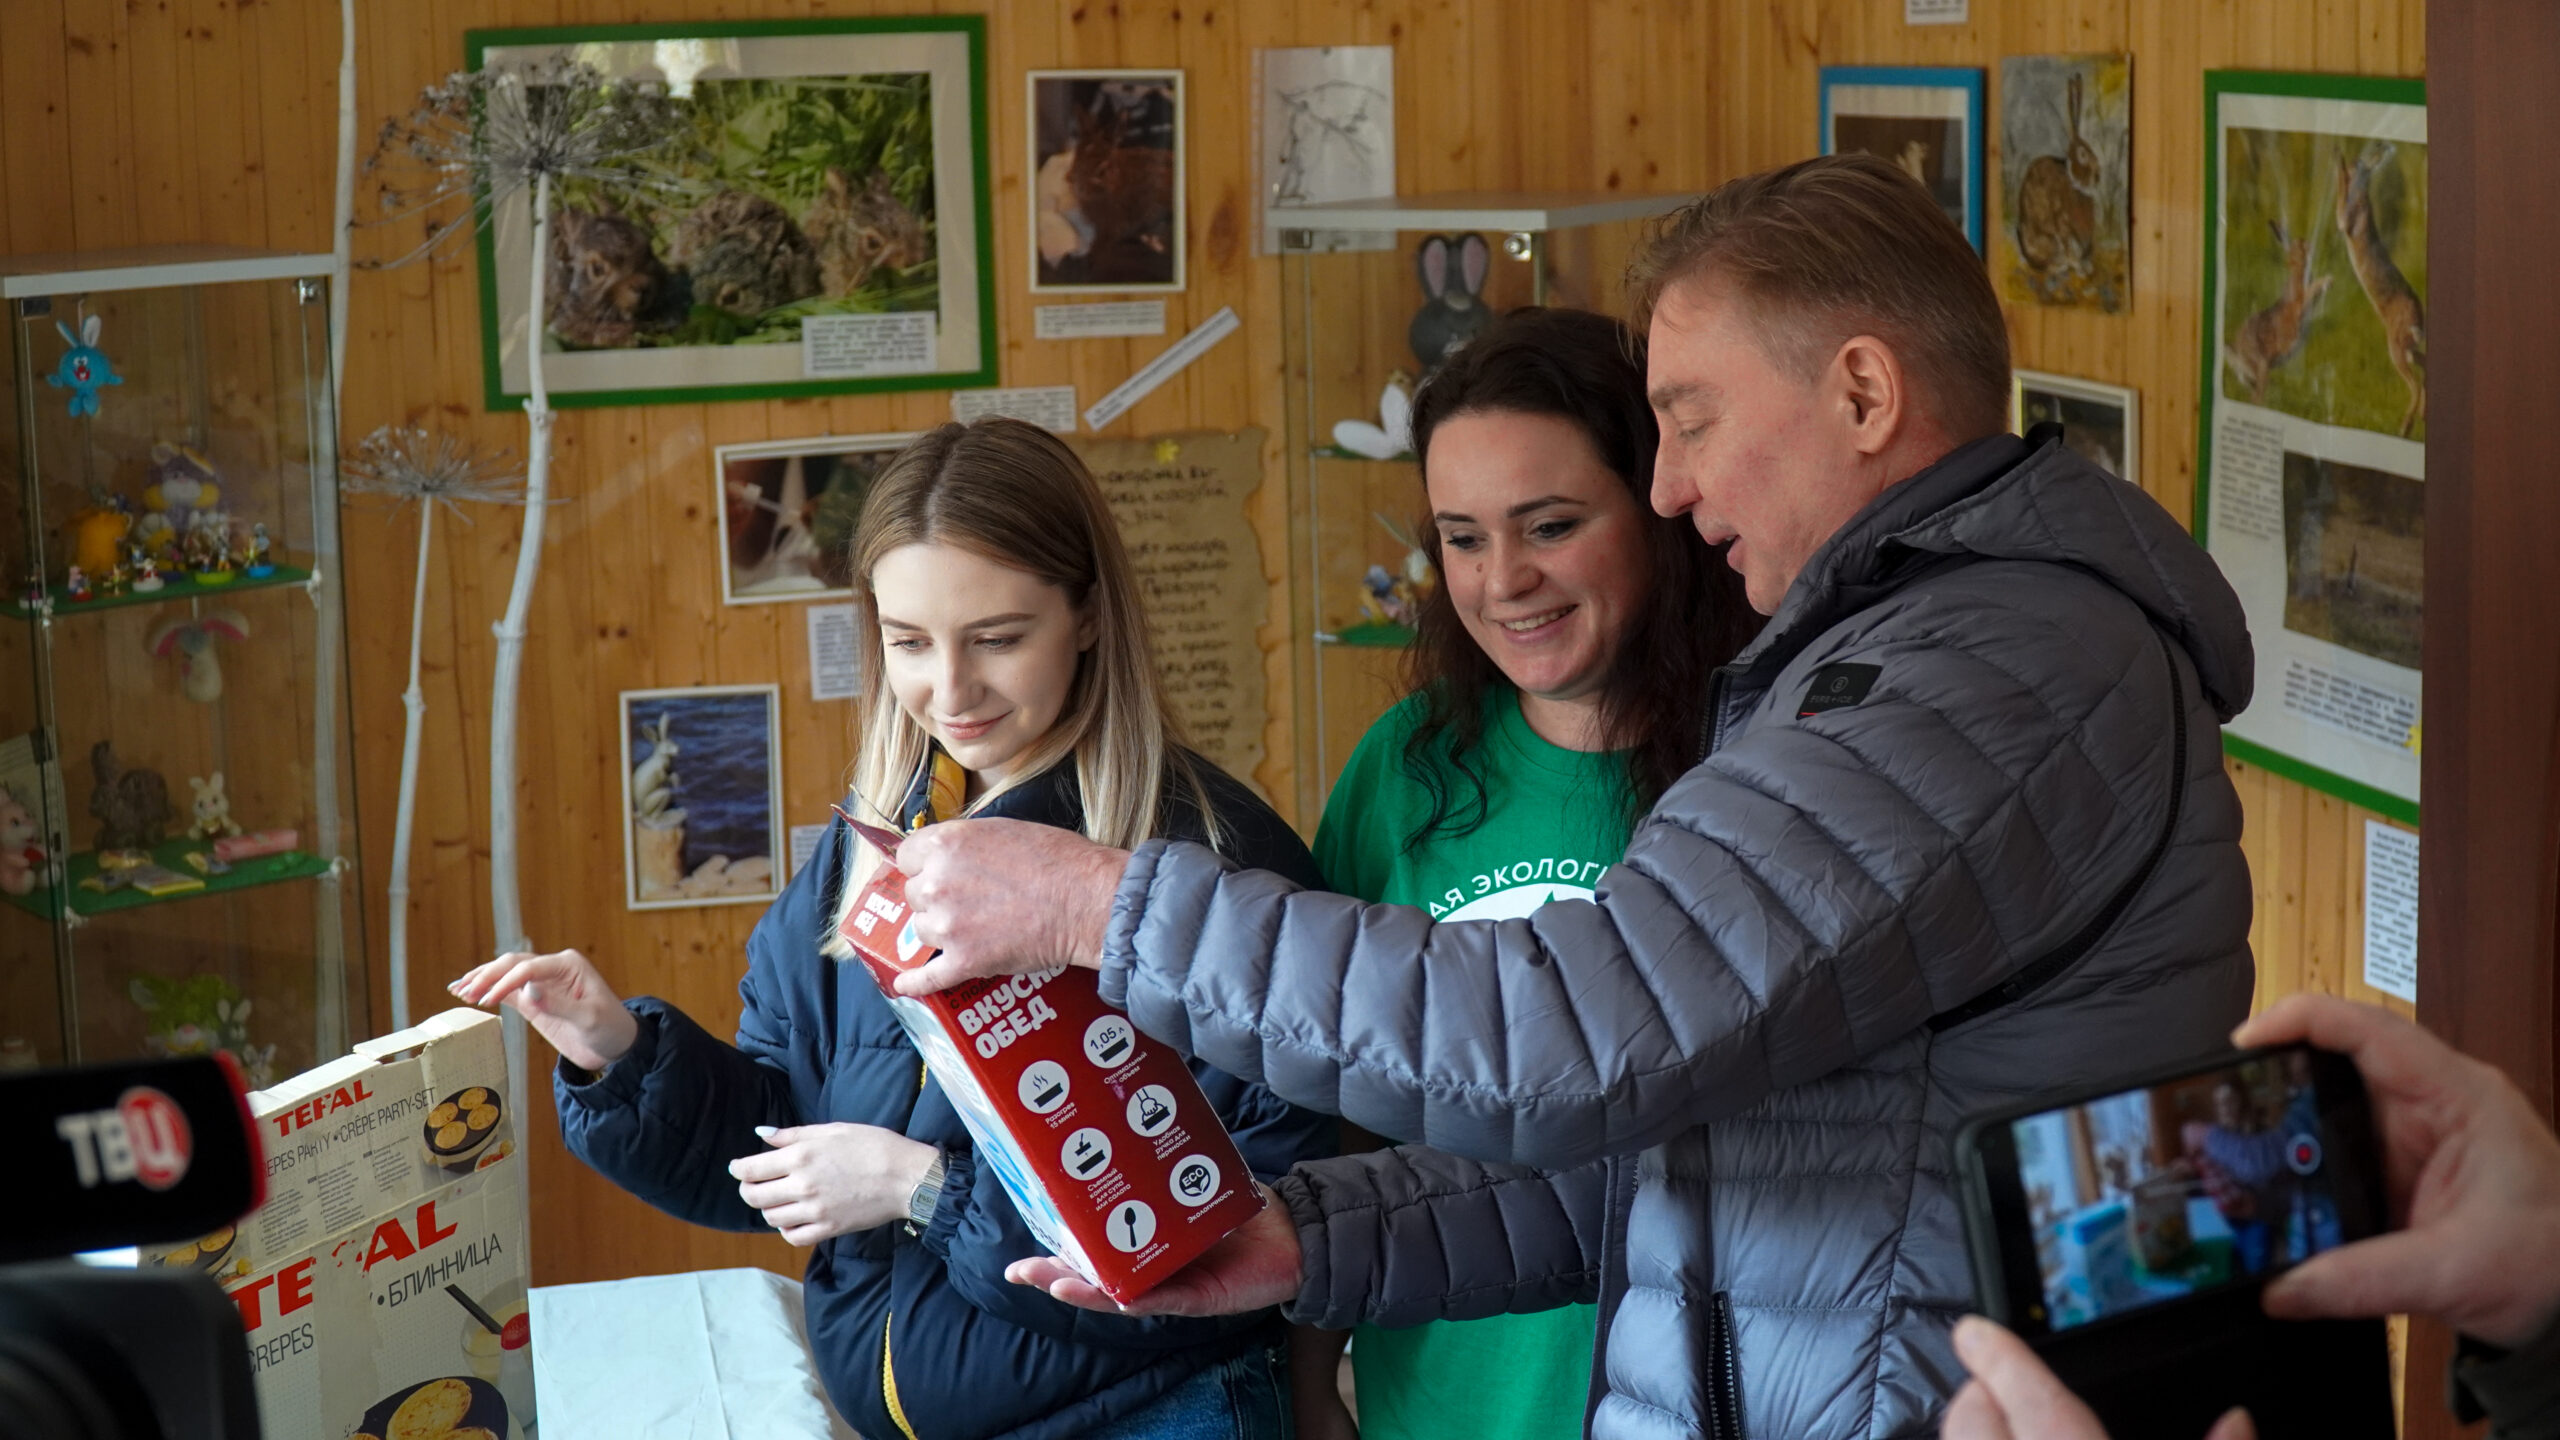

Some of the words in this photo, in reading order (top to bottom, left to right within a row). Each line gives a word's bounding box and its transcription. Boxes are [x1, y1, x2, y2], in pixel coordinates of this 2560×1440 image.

[975, 994, 1058, 1059] ОБЕД
[1090, 1026, 1117, 1050] 1,05
[1103, 1051, 1148, 1085] Оптимальный
[272, 1079, 374, 1138] TEFAL
[1044, 1101, 1076, 1125] Разогрев
[1049, 1120, 1060, 1129] 15
[1058, 1107, 1078, 1124] минут
[56, 1100, 188, 1189] ТВЦ
[264, 1149, 296, 1178] EPES
[339, 1113, 376, 1144] CRÊPE
[377, 1085, 436, 1127] PARTY-SET
[1152, 1125, 1181, 1147] Удобная
[1154, 1139, 1175, 1155] ручка
[1174, 1129, 1187, 1142] для
[1157, 1134, 1191, 1161] переноски
[1087, 1168, 1118, 1192] Съемный
[1089, 1172, 1123, 1199] контейнер
[1181, 1166, 1205, 1187] ECO
[1095, 1200, 1109, 1212] или
[1107, 1183, 1132, 1203] салата
[1096, 1191, 1109, 1204] для
[1107, 1180, 1125, 1195] супа
[1187, 1188, 1235, 1224] Экологичность
[1136, 1242, 1159, 1261] Ложка
[1136, 1242, 1170, 1270] комплекте
[227, 1200, 458, 1334] TEAL
[388, 1232, 503, 1308] БЛИННИЦА
